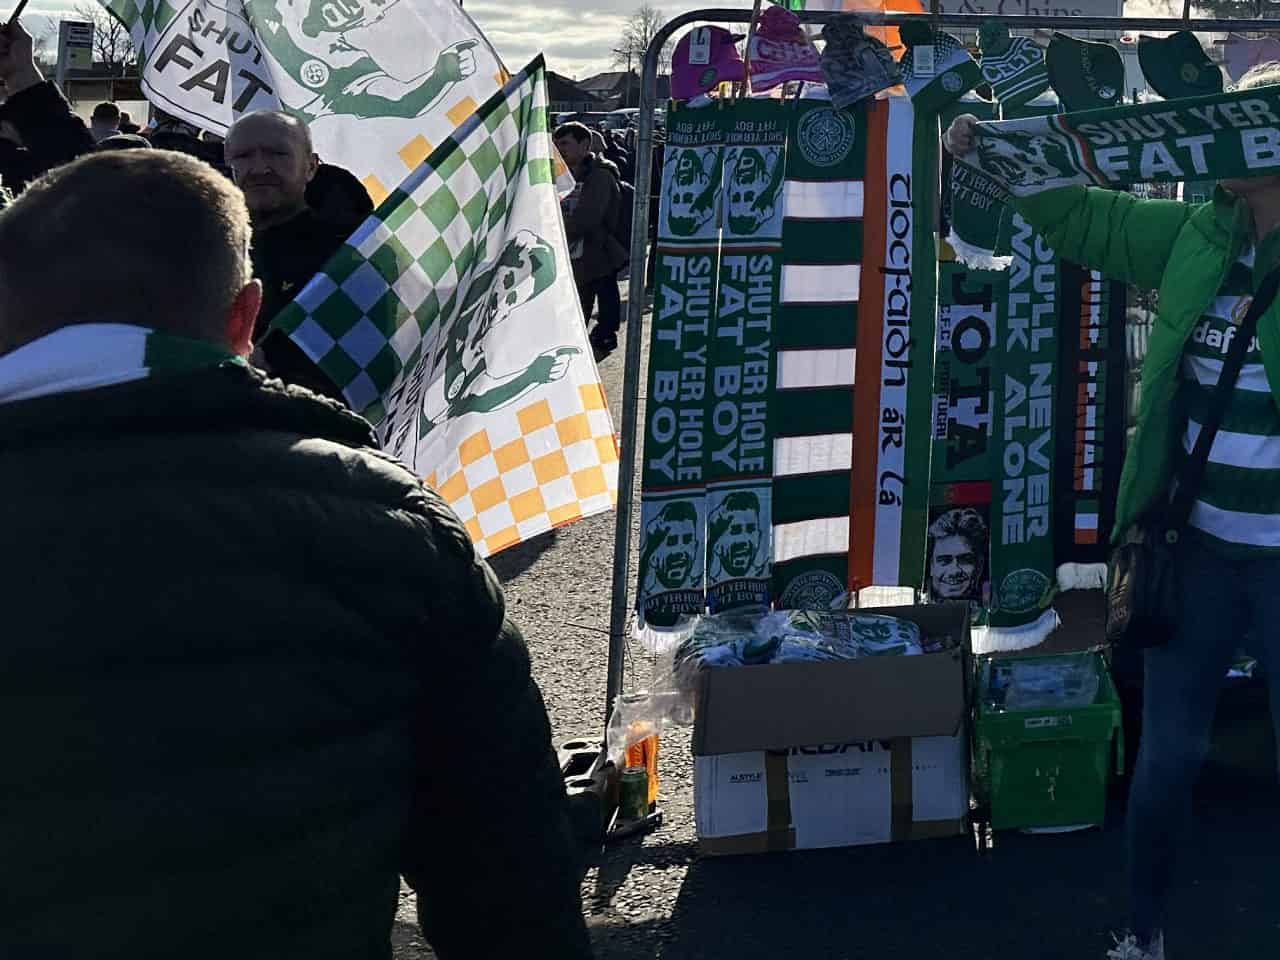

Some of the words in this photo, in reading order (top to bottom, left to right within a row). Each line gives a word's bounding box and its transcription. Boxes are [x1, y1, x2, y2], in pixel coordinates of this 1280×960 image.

[153, 33, 273, 113] FAT
[188, 7, 263, 65] SHUT
[981, 41, 1043, 83] CELTS
[1078, 104, 1190, 144] SHUT
[1189, 90, 1271, 133] YER
[1096, 138, 1217, 183] FAT
[970, 190, 994, 212] BOY
[657, 255, 686, 351] FAT
[684, 255, 712, 336] SHUT
[716, 254, 747, 347] FAT
[745, 254, 774, 333] SHUT
[1006, 211, 1034, 353] WALK
[1031, 232, 1055, 353] OU'LL
[680, 343, 708, 403] YER
[743, 338, 771, 396] YER
[946, 271, 993, 471] JOTA
[649, 370, 680, 482] BOY
[677, 408, 705, 482] HOLE
[711, 364, 742, 473] BOY
[738, 400, 768, 473] HOLE
[1026, 361, 1053, 542] NEVER
[1001, 373, 1028, 545] ALONE
